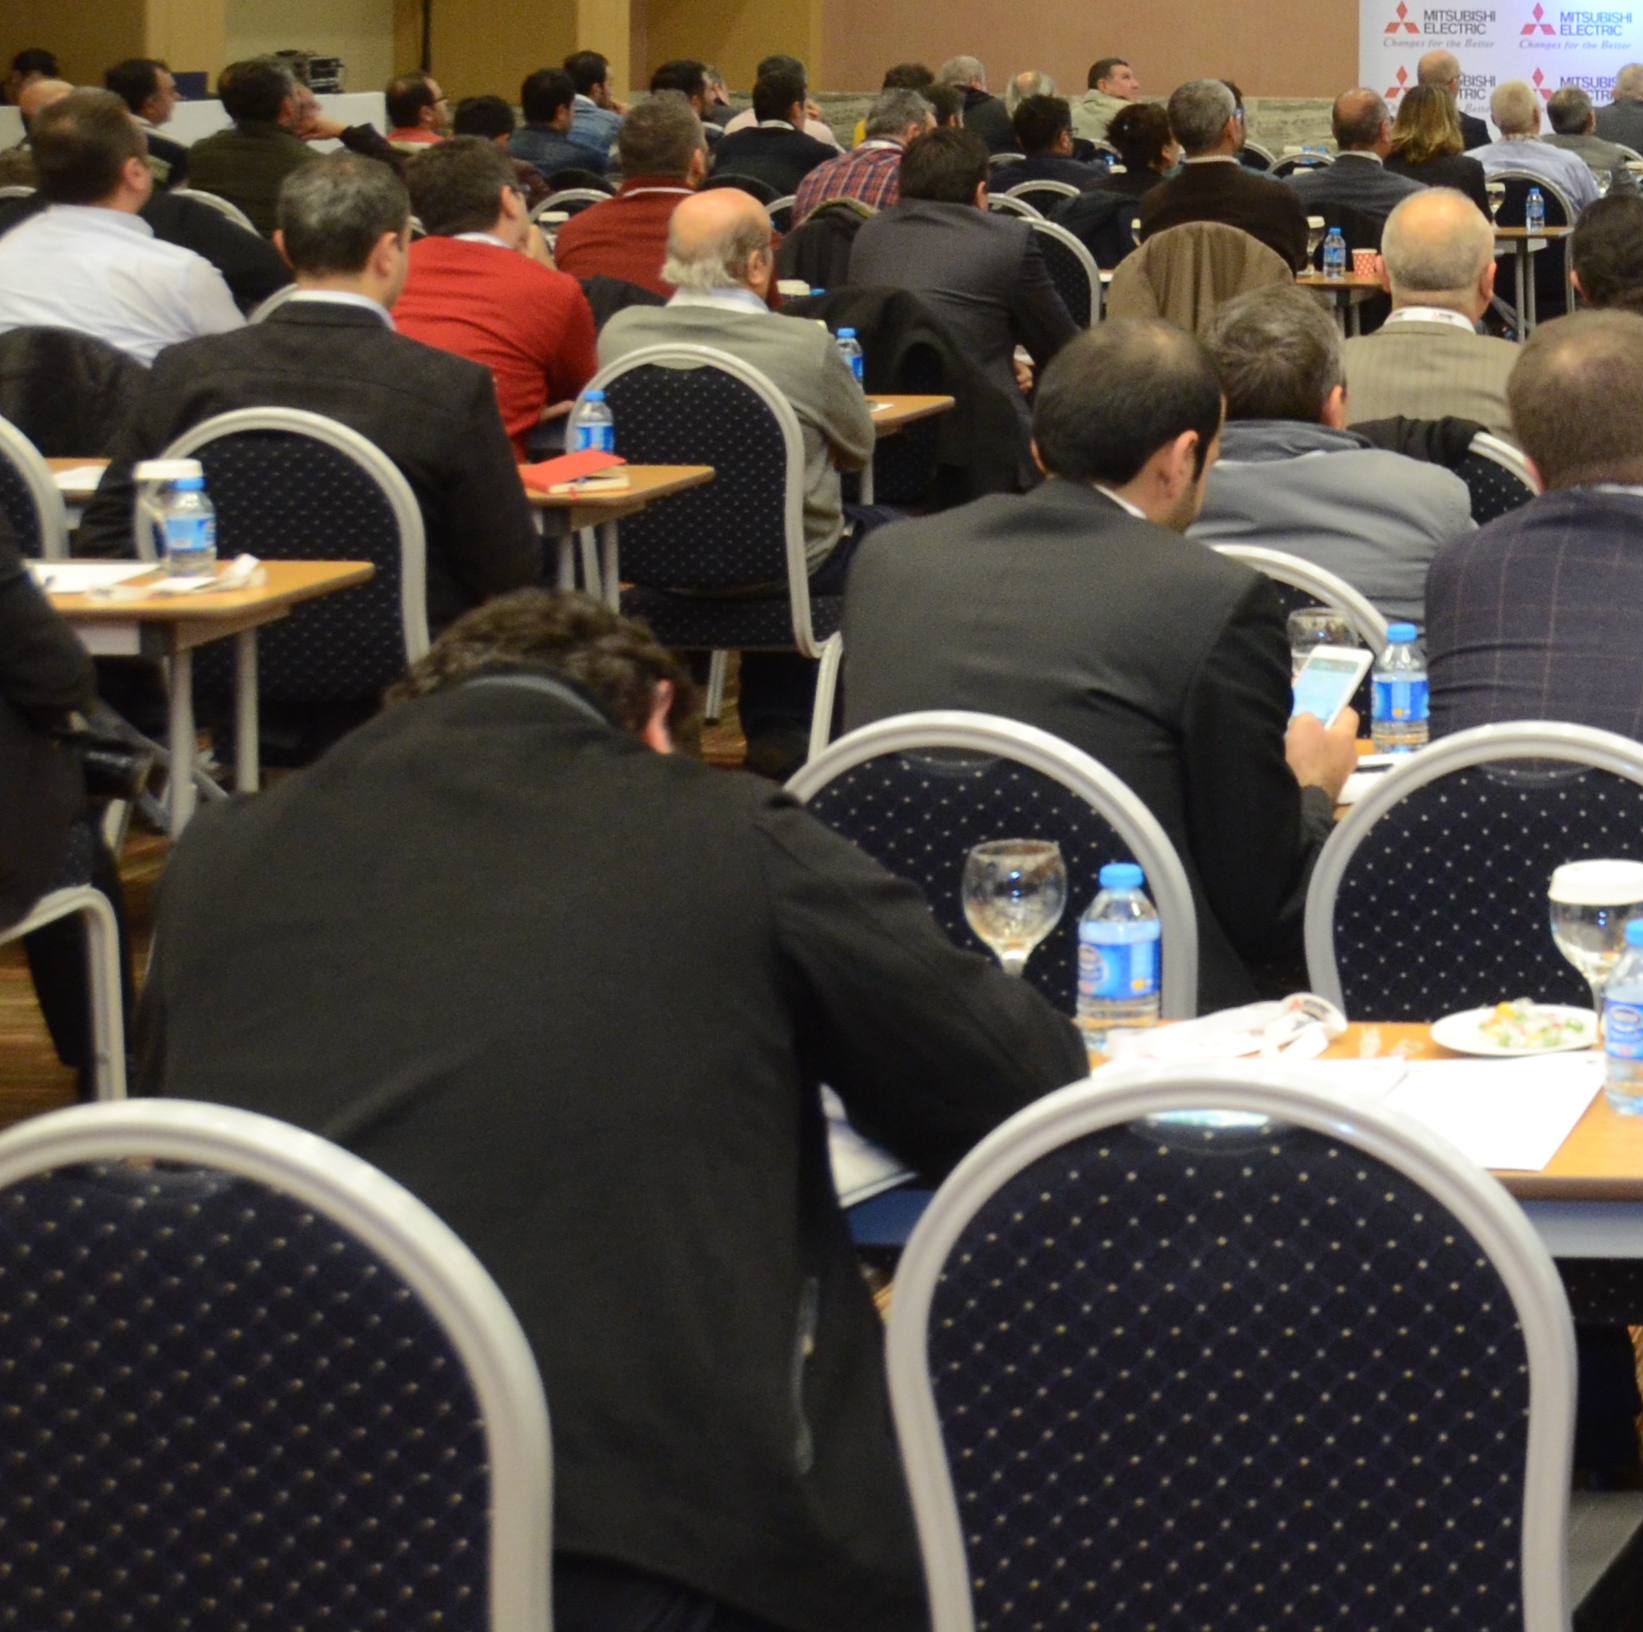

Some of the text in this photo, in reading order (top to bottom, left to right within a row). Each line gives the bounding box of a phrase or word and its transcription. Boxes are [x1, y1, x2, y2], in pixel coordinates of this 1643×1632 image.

[1423, 9, 1496, 23] MITSUBISHI
[1559, 10, 1632, 24] MITSUBISHI
[1423, 23, 1487, 36] ELECTRIC
[1559, 24, 1623, 37] ELECTRIC
